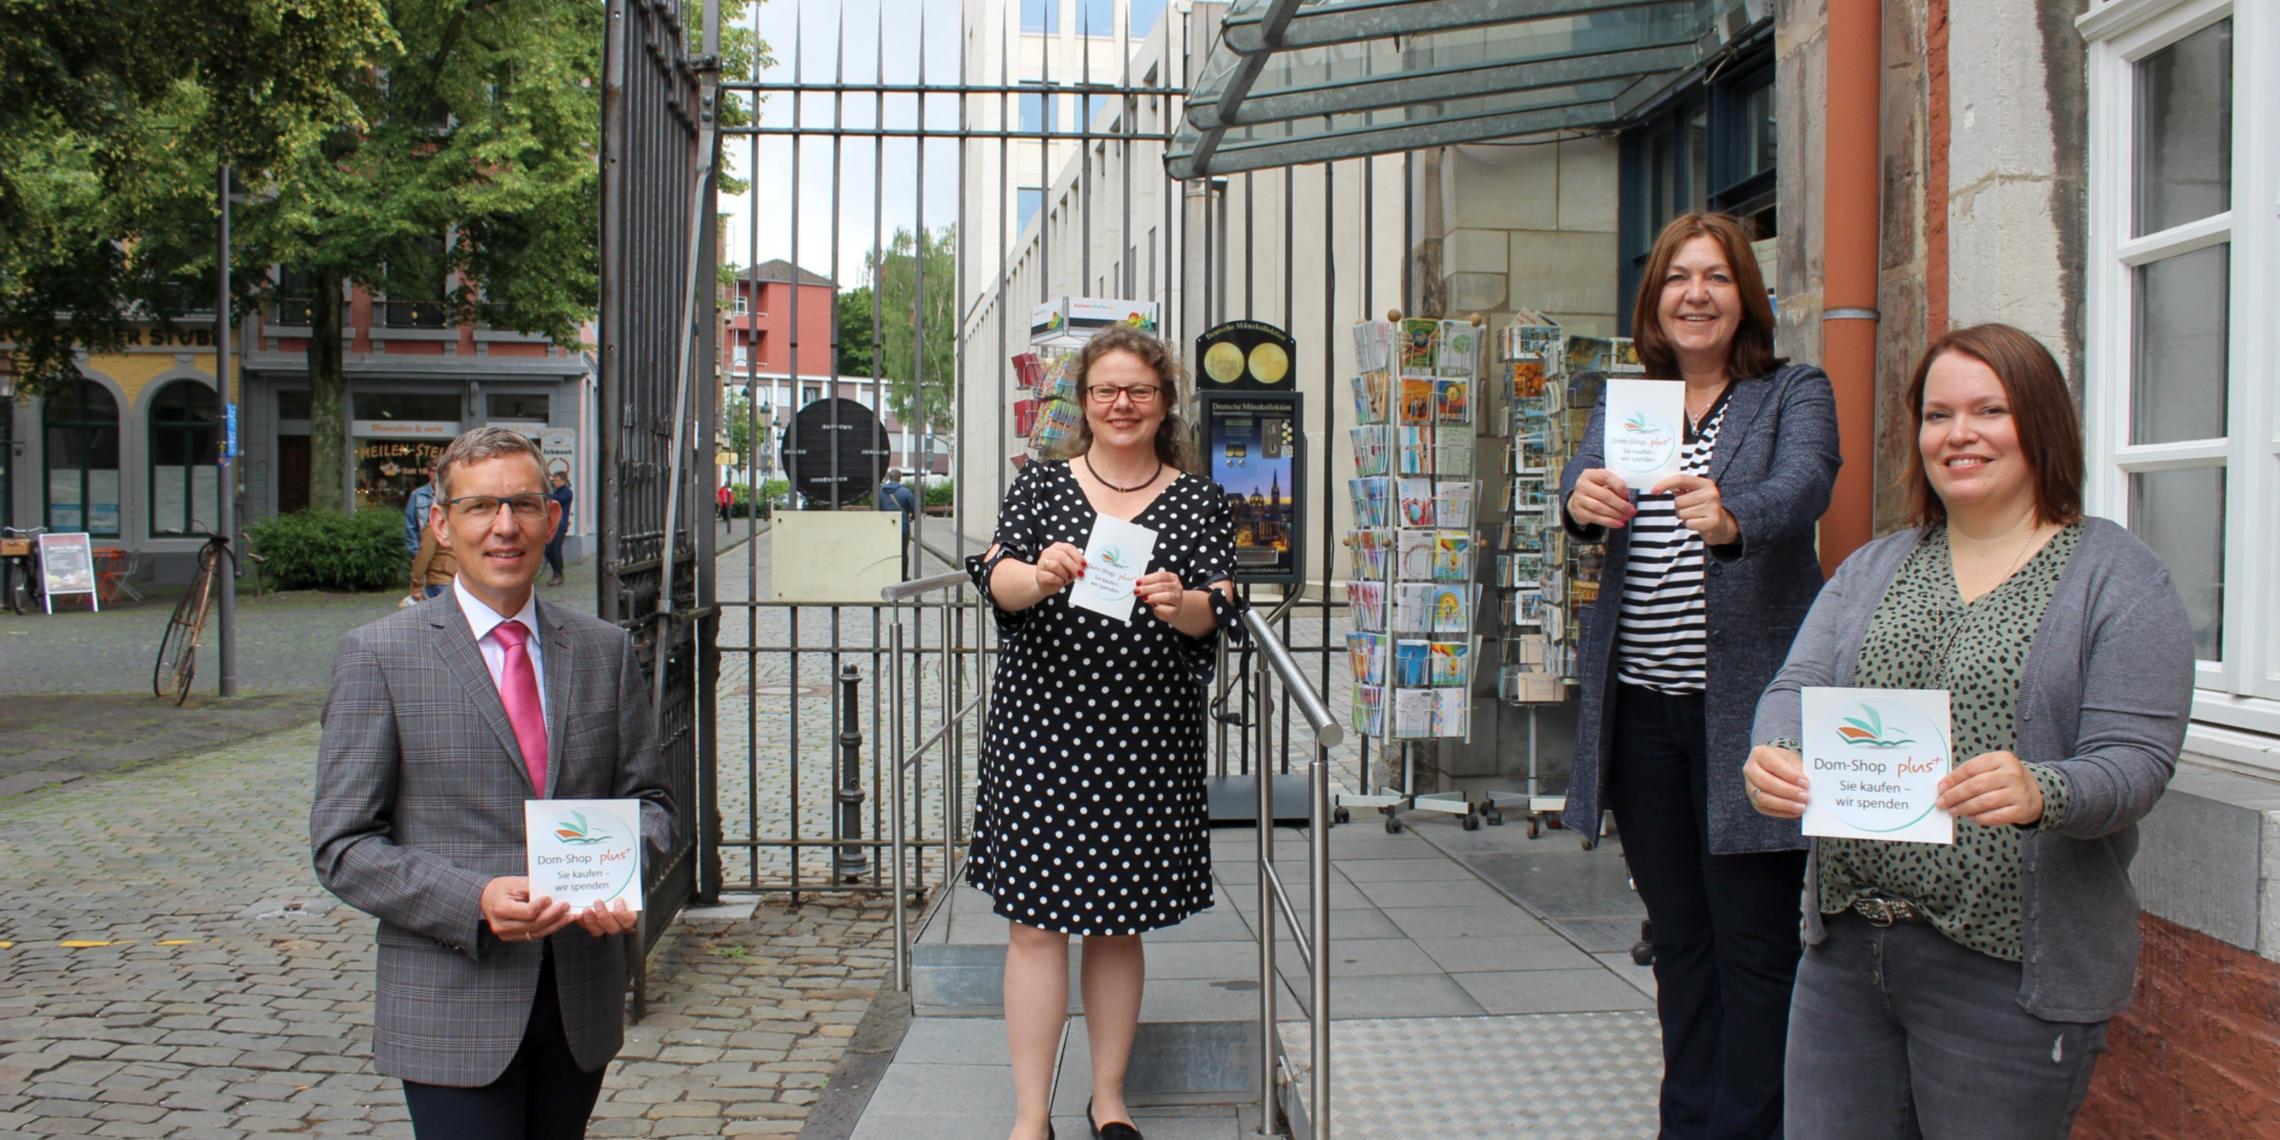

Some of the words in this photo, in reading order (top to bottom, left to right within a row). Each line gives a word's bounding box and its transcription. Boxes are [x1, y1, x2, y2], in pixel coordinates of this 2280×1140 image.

[1212, 403, 1241, 411] Deutsche
[1813, 757, 1887, 775] Dom-Shop
[1839, 780, 1857, 792] Sie
[1860, 781, 1901, 793] kaufen
[1835, 797, 1854, 807] wir
[1857, 798, 1909, 811] spenden
[537, 853, 592, 866] Dom-Shop
[556, 870, 571, 880] Sie
[572, 868, 603, 879] kaufen
[554, 883, 569, 892] wir
[570, 881, 609, 892] spenden
